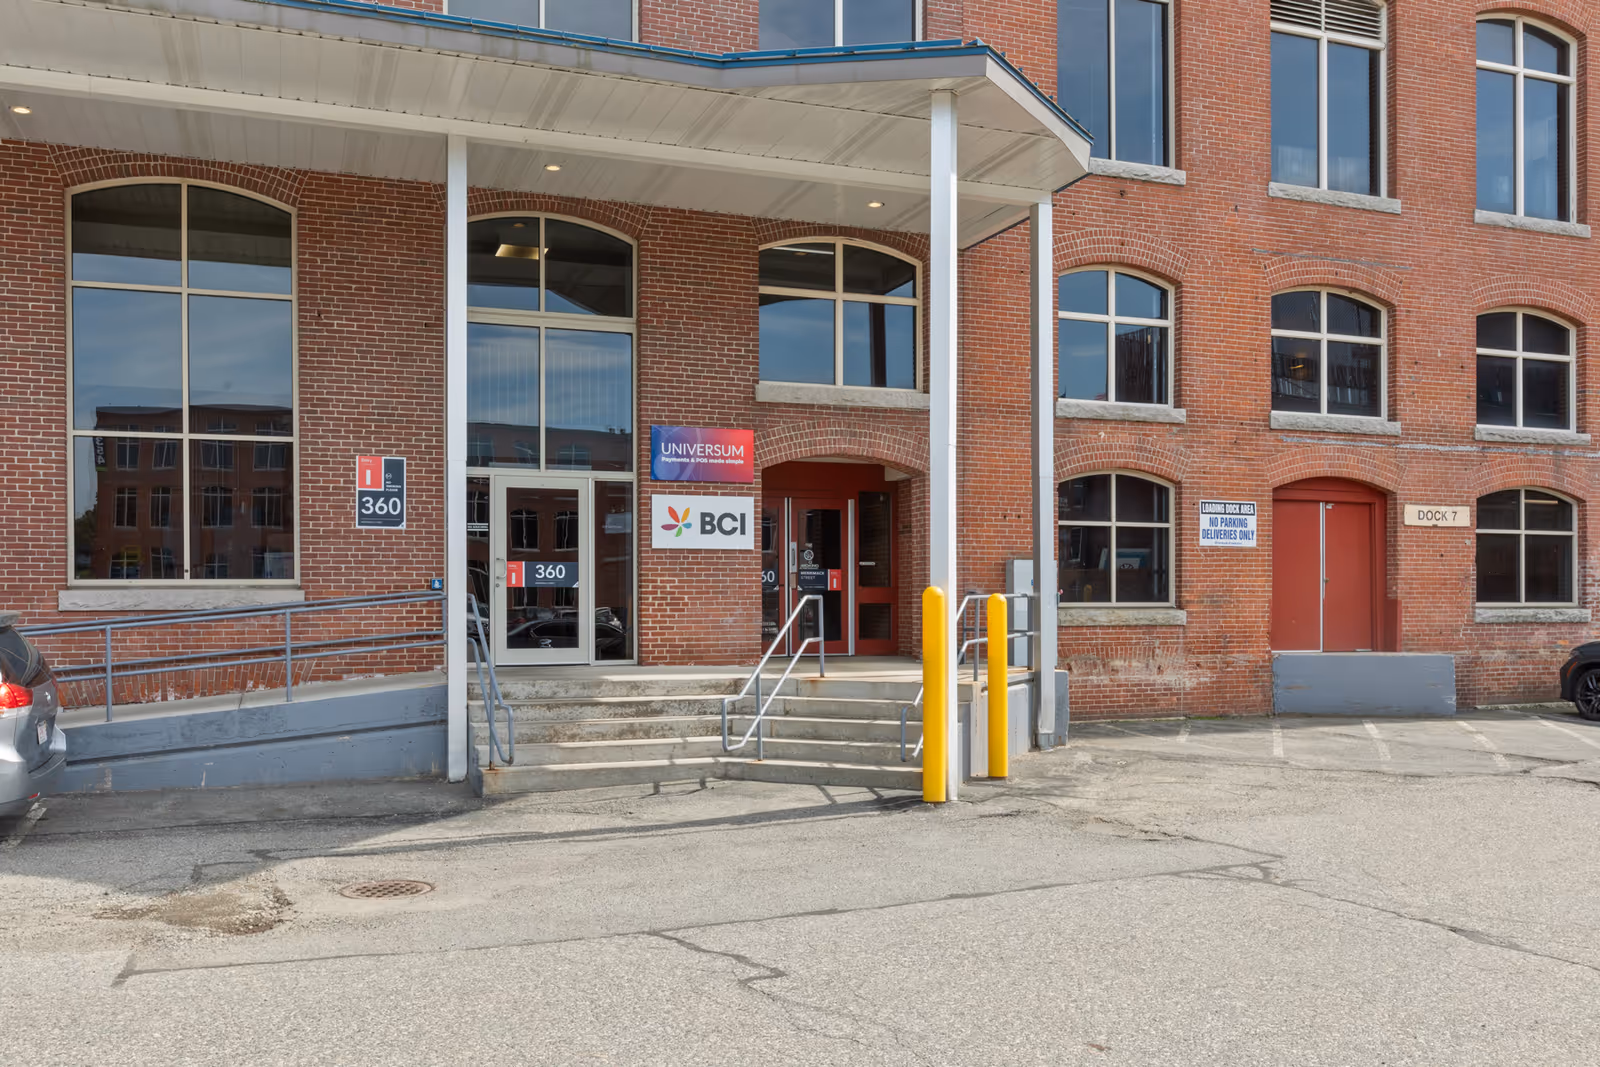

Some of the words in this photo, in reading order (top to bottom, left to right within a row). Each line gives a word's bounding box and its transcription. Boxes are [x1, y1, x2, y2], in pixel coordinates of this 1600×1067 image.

[661, 442, 744, 457] UNIVERSUM
[361, 496, 401, 515] 360
[1202, 503, 1224, 513] LOADING
[1226, 504, 1240, 514] DOCK
[1240, 504, 1254, 514] AREA
[1209, 516, 1218, 527] NO
[1220, 517, 1248, 528] PARKING
[1418, 510, 1448, 521] DOCK
[1452, 512, 1457, 521] 7
[700, 512, 746, 536] BCI
[1202, 529, 1237, 540] DELIVERIES
[1239, 530, 1254, 540] ONLY
[535, 564, 566, 578] 360
